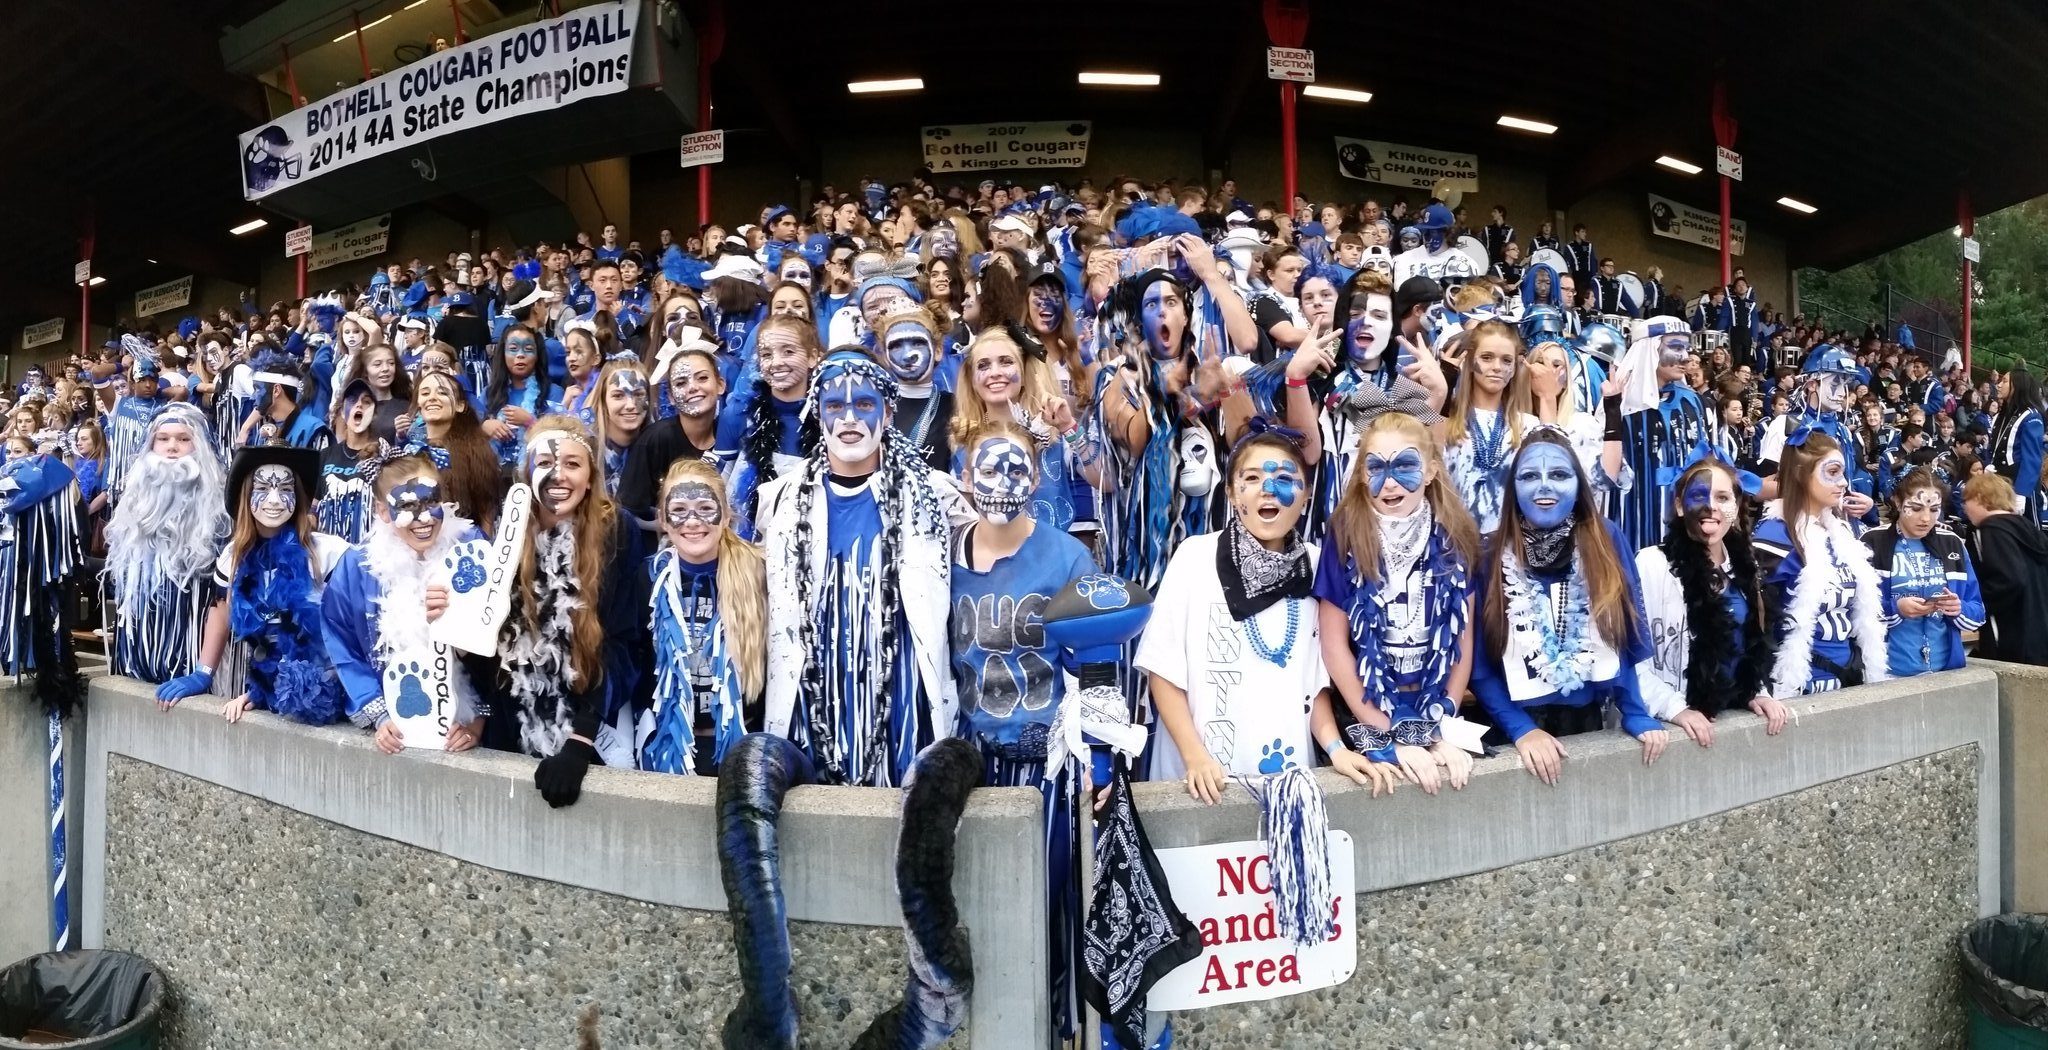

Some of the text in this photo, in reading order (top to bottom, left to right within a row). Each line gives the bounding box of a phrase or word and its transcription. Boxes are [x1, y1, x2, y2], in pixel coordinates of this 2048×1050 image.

[1270, 50, 1312, 60] STUDENT
[1270, 59, 1313, 69] SECTION
[307, 9, 631, 137] BOTHELL COUGAR FOOTBALL
[308, 54, 629, 171] 2014 4A State Champions
[987, 126, 1027, 136] 2007
[682, 133, 722, 146] STUDENT
[682, 142, 722, 154] SECTION
[925, 140, 1087, 156] Bothell Cougars
[942, 160, 953, 169] A
[961, 158, 1019, 169] Kingco
[1026, 156, 1082, 166] Champ
[1388, 151, 1472, 169] KINGCO 4A
[1719, 148, 1742, 164] BAND
[1382, 162, 1477, 179] CHAMPIONS
[1683, 209, 1721, 225] KINGC
[287, 228, 311, 240] STUDENT
[287, 236, 311, 247] SECTION
[342, 230, 390, 249] Cougars
[353, 243, 385, 258] Champ
[814, 243, 823, 253] B
[453, 294, 460, 302] B
[481, 488, 526, 626] Cougars
[1216, 855, 1273, 897] NO
[1198, 954, 1301, 994] Area
